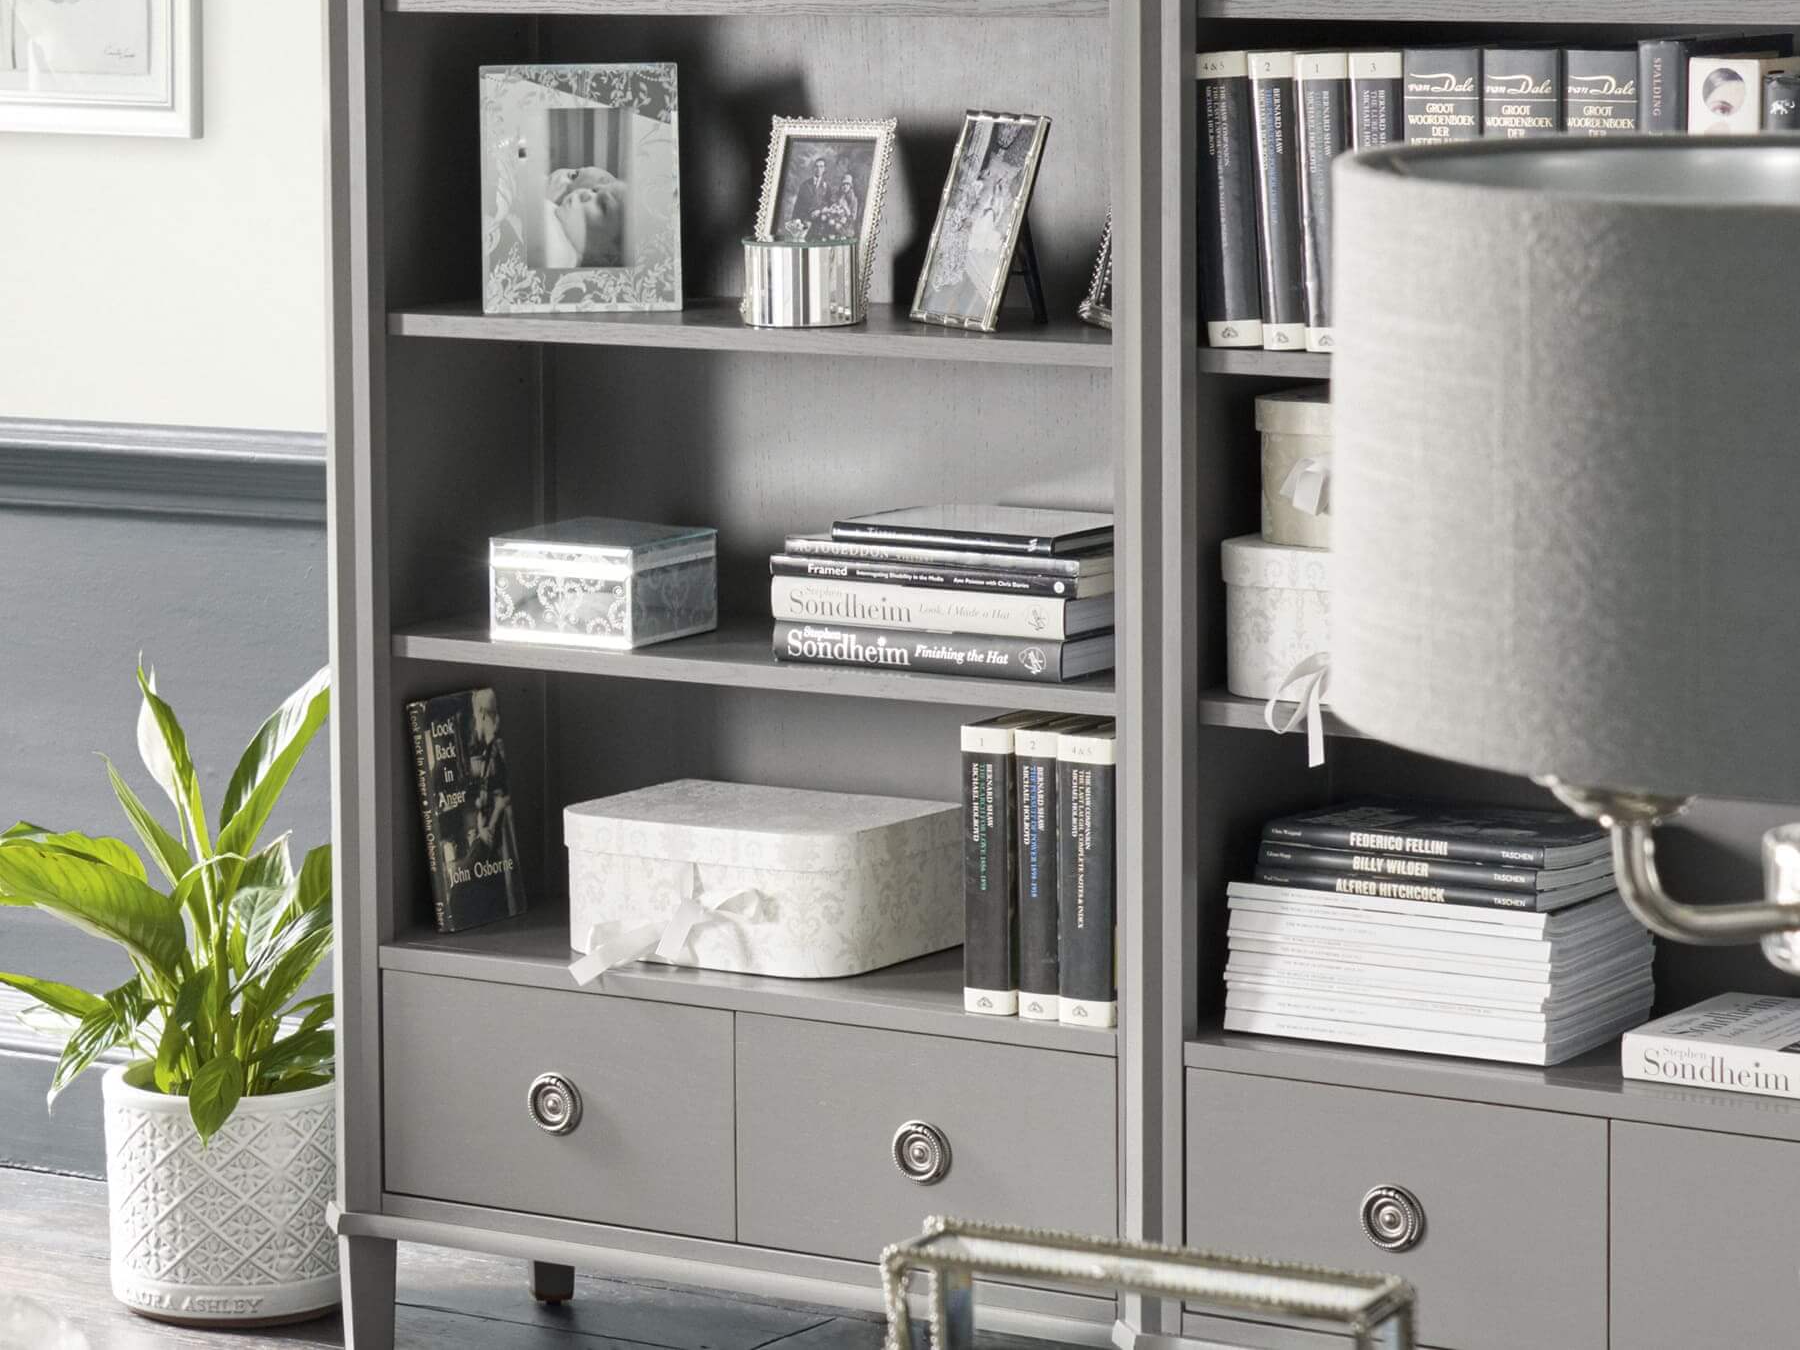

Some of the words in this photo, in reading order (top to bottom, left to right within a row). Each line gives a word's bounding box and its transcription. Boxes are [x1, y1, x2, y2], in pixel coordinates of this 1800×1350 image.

[1264, 61, 1271, 72] 2
[1369, 62, 1377, 73] 3
[1408, 83, 1430, 92] van
[1410, 73, 1474, 92] Dale
[1486, 85, 1506, 93] van
[1488, 74, 1552, 94] Dale
[1568, 85, 1588, 94] van
[1569, 75, 1635, 95] Dale
[1653, 57, 1662, 116] SPALDING
[1273, 88, 1281, 129] BERNARD
[1307, 91, 1315, 131] MICHAEL
[1322, 91, 1331, 131] BERNARD
[1363, 90, 1371, 129] MICHAEL
[1378, 90, 1386, 131] BERNARD
[1426, 103, 1455, 114] GROOT
[1502, 105, 1531, 115] GROOT
[1583, 105, 1613, 116] GROOT
[1408, 114, 1475, 125] WOORDENBOEK
[1486, 116, 1553, 127] WOORDENBOEK
[1567, 117, 1634, 129] WOORDENBOEK
[1431, 126, 1449, 136] DER
[1507, 128, 1525, 138] DER
[1275, 130, 1283, 154] SHAW
[1323, 133, 1331, 156] SHAW
[807, 562, 848, 576] Framed
[789, 589, 911, 623] Sondheim
[990, 609, 1011, 620] Hat
[803, 625, 841, 640] Stephen
[787, 628, 911, 666] Sondheim
[914, 644, 966, 665] Finishing
[966, 649, 985, 663] the
[986, 650, 1009, 665] Hat
[431, 718, 455, 738] Look
[435, 741, 456, 761] Back
[1029, 740, 1037, 751] 2
[443, 766, 454, 783] in
[985, 763, 993, 803] BERNARD
[1036, 766, 1044, 806] BERNARD
[1071, 769, 1079, 802] MICHAEL
[438, 791, 466, 809] Anger
[972, 803, 980, 841] HOLROYD
[1023, 806, 1031, 845] HOLROYD
[1031, 820, 1037, 832] OF
[1071, 803, 1079, 837] HOLROYD
[1350, 832, 1403, 850] FEDERICO
[1405, 837, 1448, 856] FELLINI
[1501, 850, 1534, 861] TASCHEN
[449, 867, 471, 889] John
[474, 858, 514, 879] Osborne
[1352, 856, 1386, 873] BILLY
[1387, 859, 1429, 878] WILDER
[1493, 873, 1526, 883] TASCHEN
[1335, 878, 1377, 896] ALFRED
[1379, 882, 1445, 903] HITCHCOCK
[1493, 897, 1526, 907] TASCHEN
[1662, 1043, 1706, 1060] Stephen
[1642, 1047, 1790, 1092] Sondheim
[181, 1296, 264, 1314] ASHLEY
